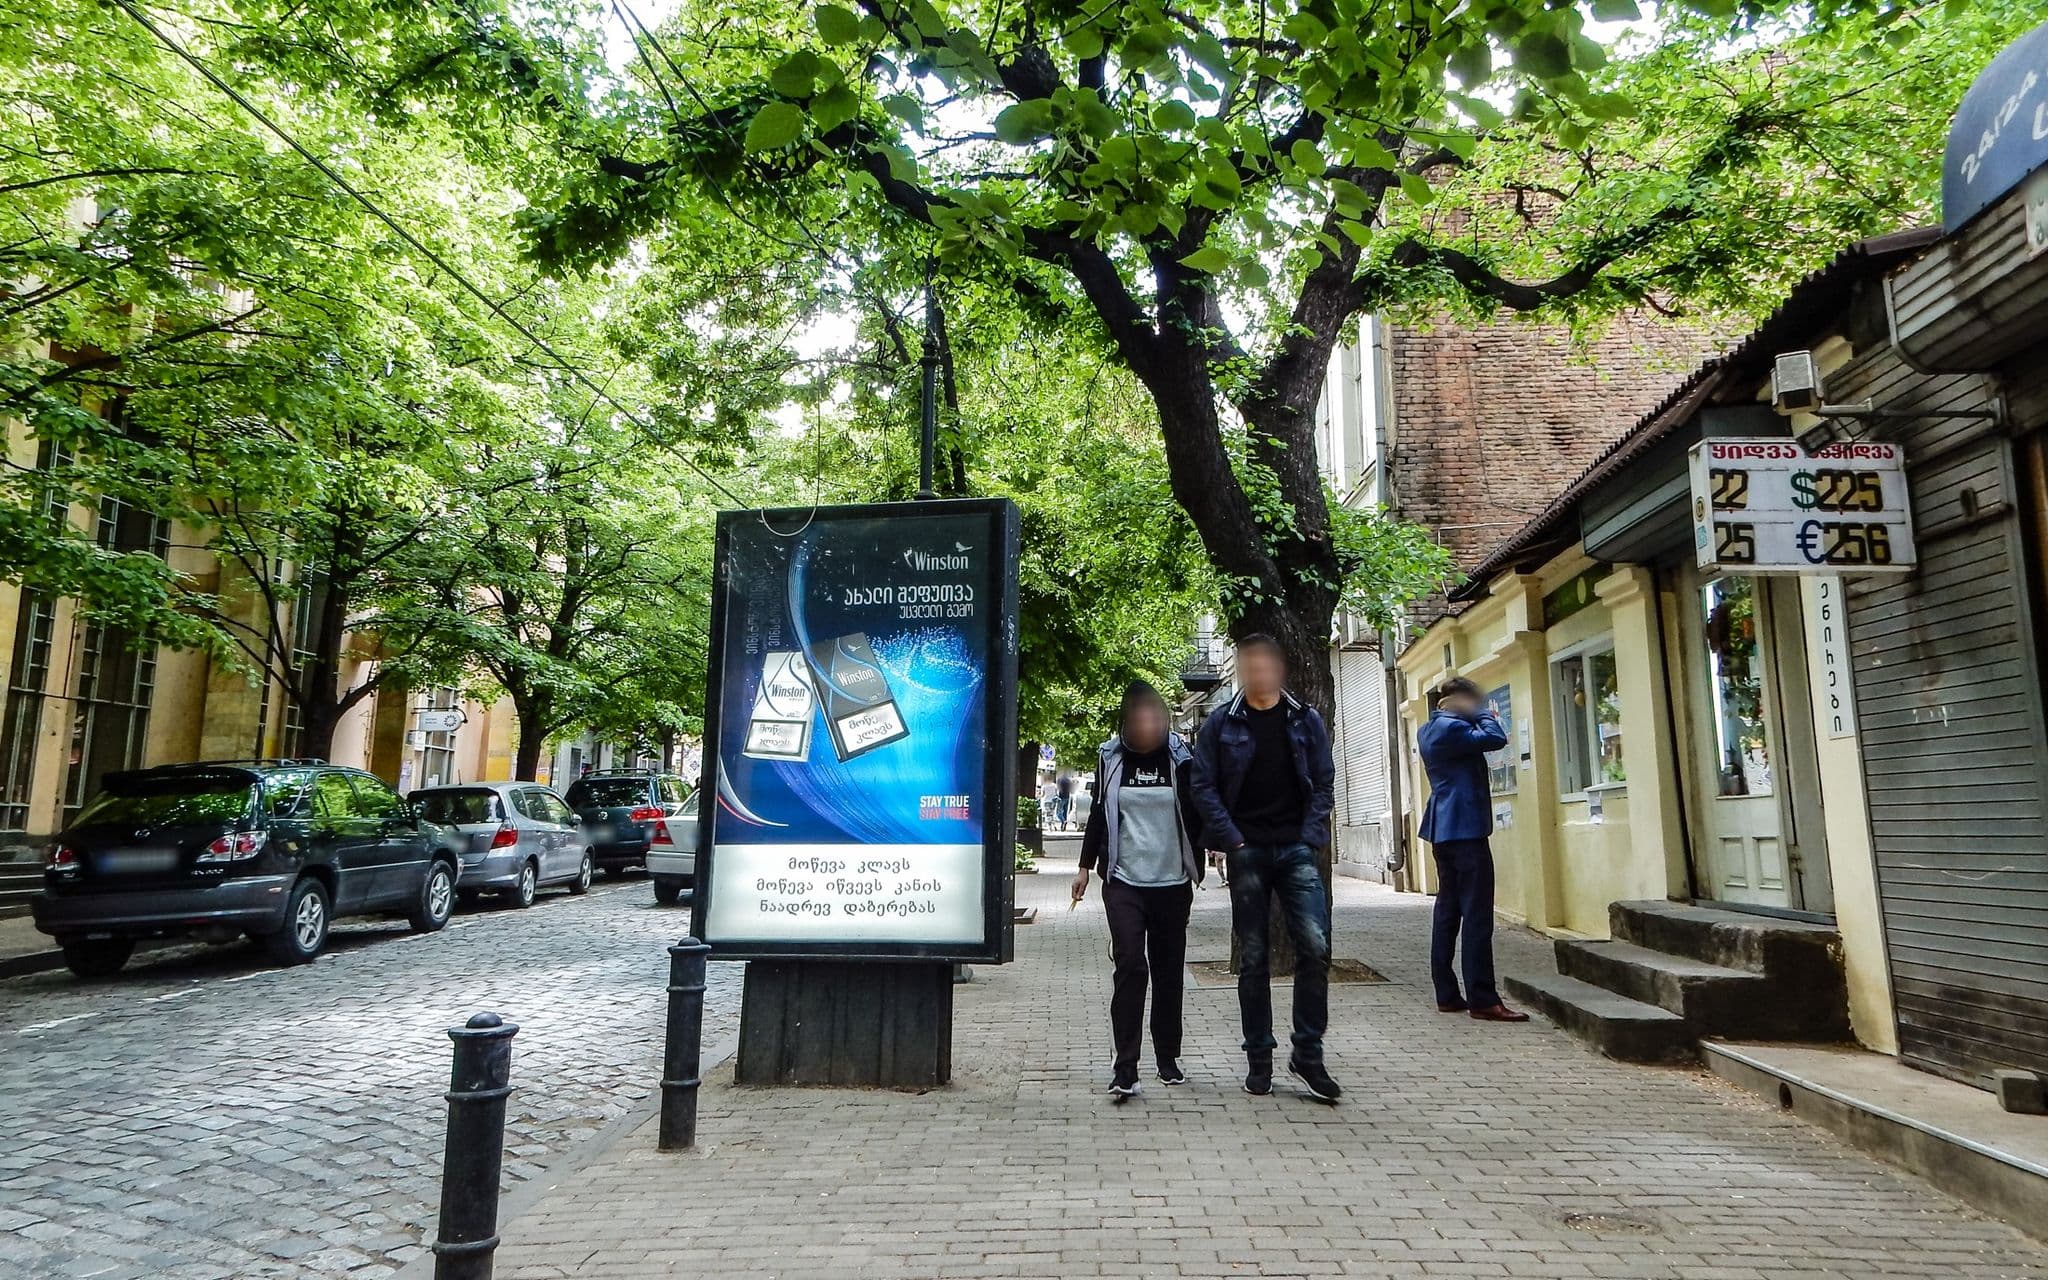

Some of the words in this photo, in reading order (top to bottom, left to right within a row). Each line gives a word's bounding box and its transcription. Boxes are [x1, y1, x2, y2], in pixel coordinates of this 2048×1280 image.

[1712, 445, 1797, 459] ყიდვა
[913, 550, 969, 571] Winston
[844, 586, 893, 606] ახალი
[897, 584, 974, 603] შეფუთვა
[946, 603, 974, 617] გემო
[837, 669, 875, 687] Winston
[771, 683, 806, 698] Winston
[920, 795, 942, 808] STAY
[943, 795, 969, 808] TRUE
[788, 857, 846, 873] მოწევა
[857, 857, 911, 873] კლავს
[756, 878, 814, 894] მოწევა
[825, 879, 883, 895] იწვევს
[894, 879, 942, 895] კანის
[760, 899, 831, 916] ნაადრევ
[843, 900, 936, 916] დაბერებას
